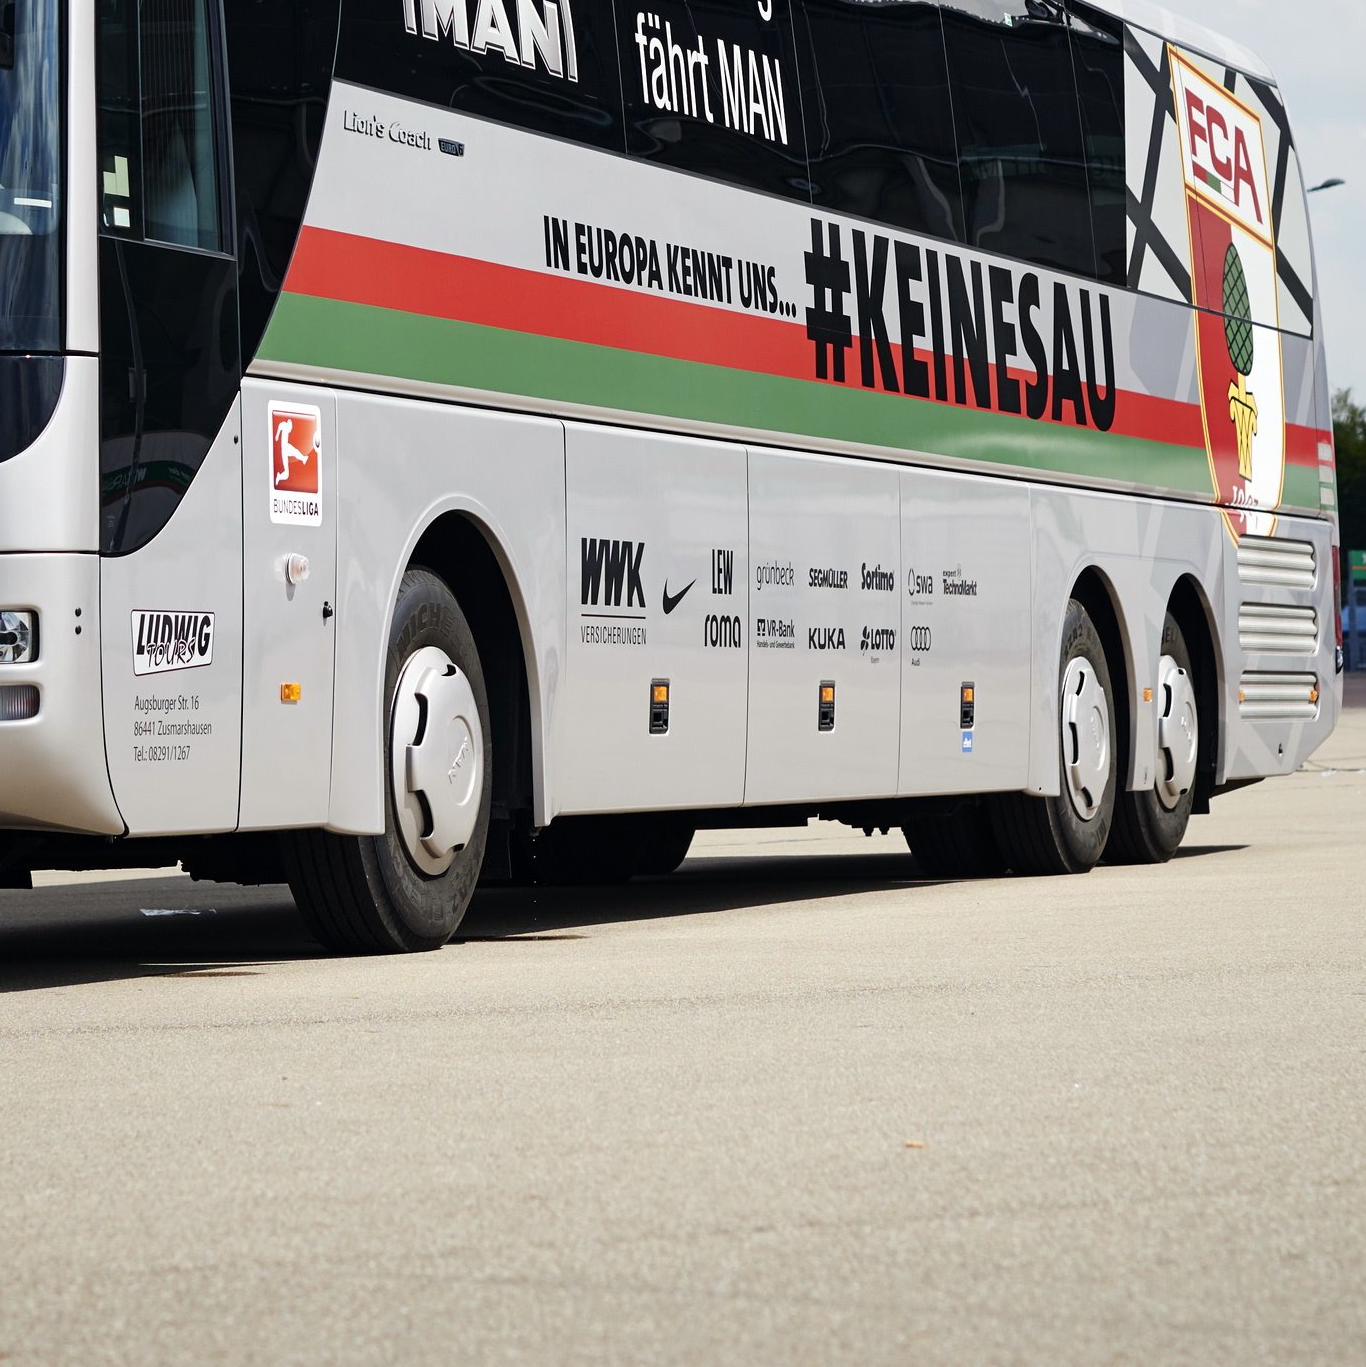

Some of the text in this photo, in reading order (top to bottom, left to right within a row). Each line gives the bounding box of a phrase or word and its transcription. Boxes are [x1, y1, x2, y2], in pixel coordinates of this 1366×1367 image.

[634, 11, 789, 146] fährt MAN
[343, 109, 432, 151] Lion's Coach
[440, 141, 456, 154] EURO
[1185, 86, 1264, 225] FCA
[543, 215, 570, 272] IN
[574, 222, 664, 291] EUROPA
[666, 243, 733, 305] KENNT
[803, 217, 1116, 432] #KEINESAU
[273, 498, 319, 517] BUNDESLIGA
[581, 537, 646, 608] WWK
[711, 548, 734, 595] LEW
[756, 559, 795, 591] grünbeck
[808, 567, 849, 589] SEGMÜLLER
[861, 562, 895, 592] Sortimo
[942, 570, 957, 578] expert
[916, 575, 933, 595] swa
[942, 579, 978, 596] TechnoMarkt
[136, 613, 212, 657] LUDWIG
[580, 625, 647, 645] VERSICHERUNGEN
[704, 614, 741, 648] roma
[808, 627, 846, 650] KUKA
[870, 628, 895, 651] LOTTO
[146, 636, 197, 668] TOURS
[134, 694, 200, 715] Augsburger Str. 16
[133, 719, 212, 737] 86441 Zusmarshausen
[148, 745, 191, 762] 08291/1267
